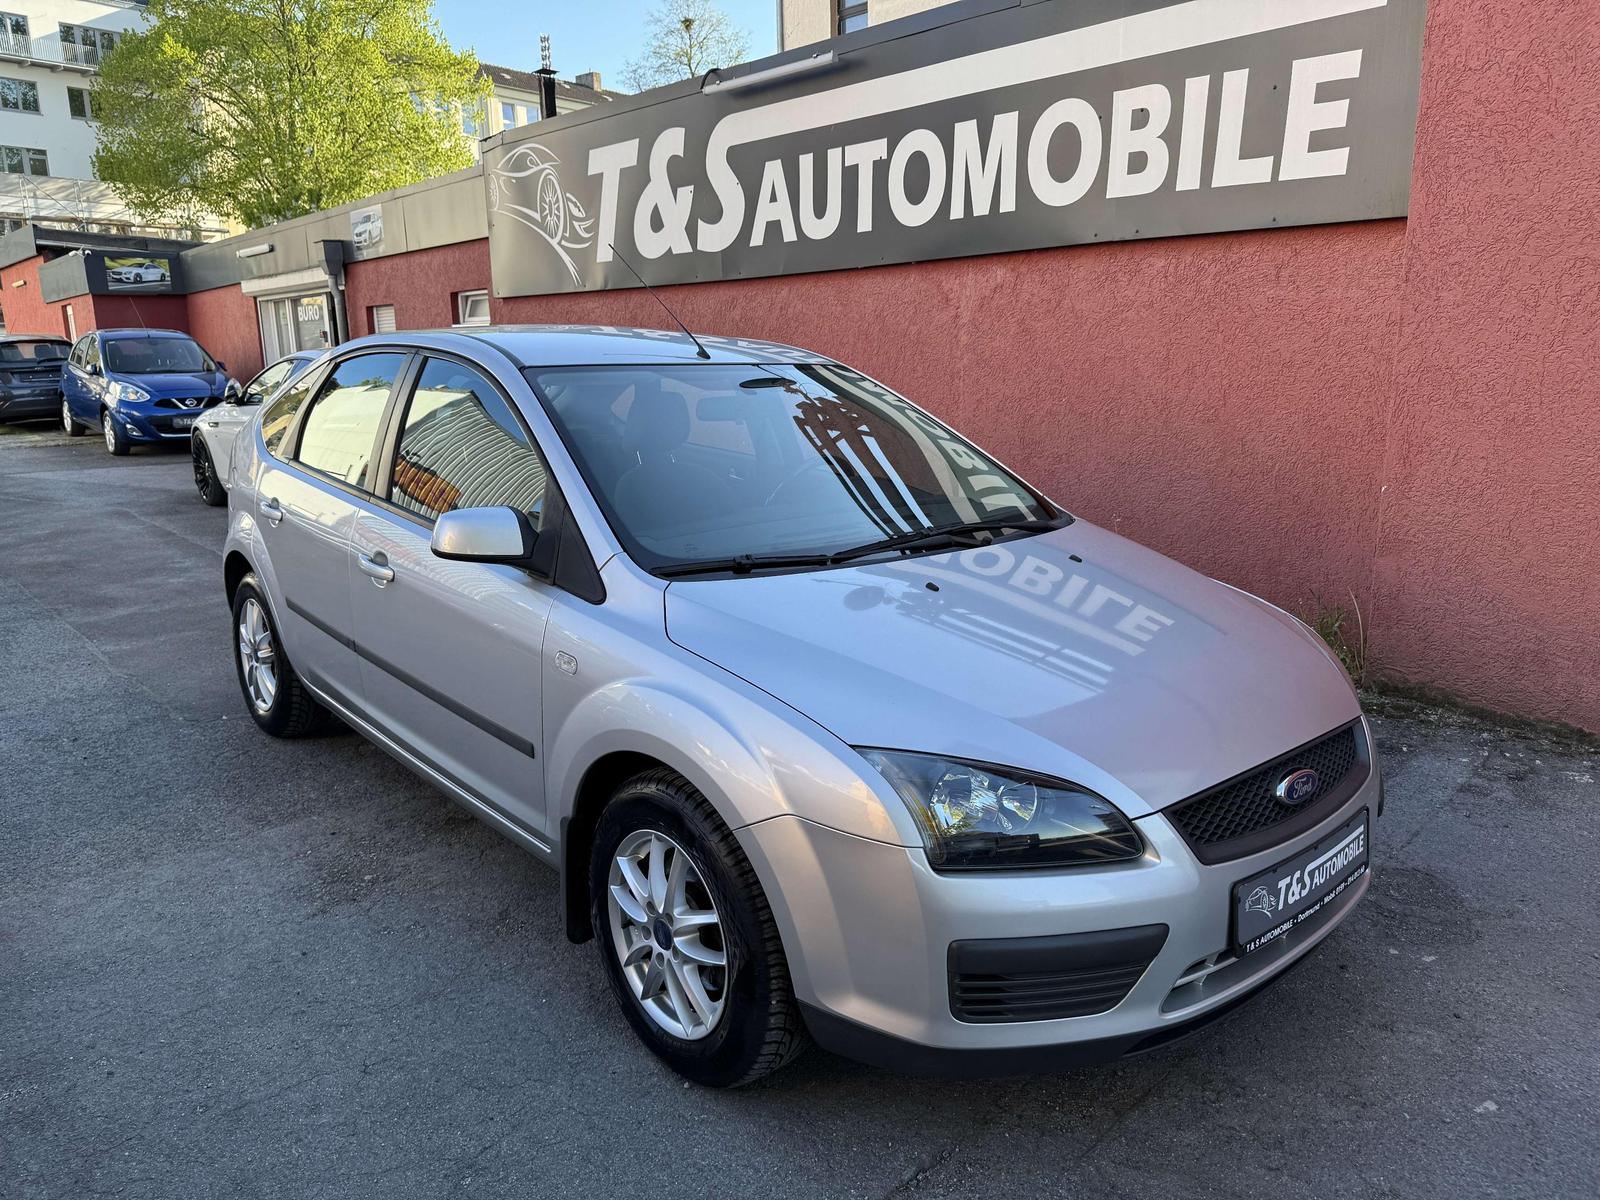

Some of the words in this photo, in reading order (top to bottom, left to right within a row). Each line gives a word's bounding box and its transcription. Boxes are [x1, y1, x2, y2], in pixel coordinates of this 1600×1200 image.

[587, 112, 742, 263] T&S
[749, 49, 1363, 247] AUTOMOBILE
[1293, 776, 1313, 799] Ford
[1277, 865, 1312, 911] T&S
[1312, 834, 1364, 890] AUTOMOBILE
[1260, 919, 1293, 944] AUTOMOBILE
[1298, 903, 1321, 922] Dortmund
